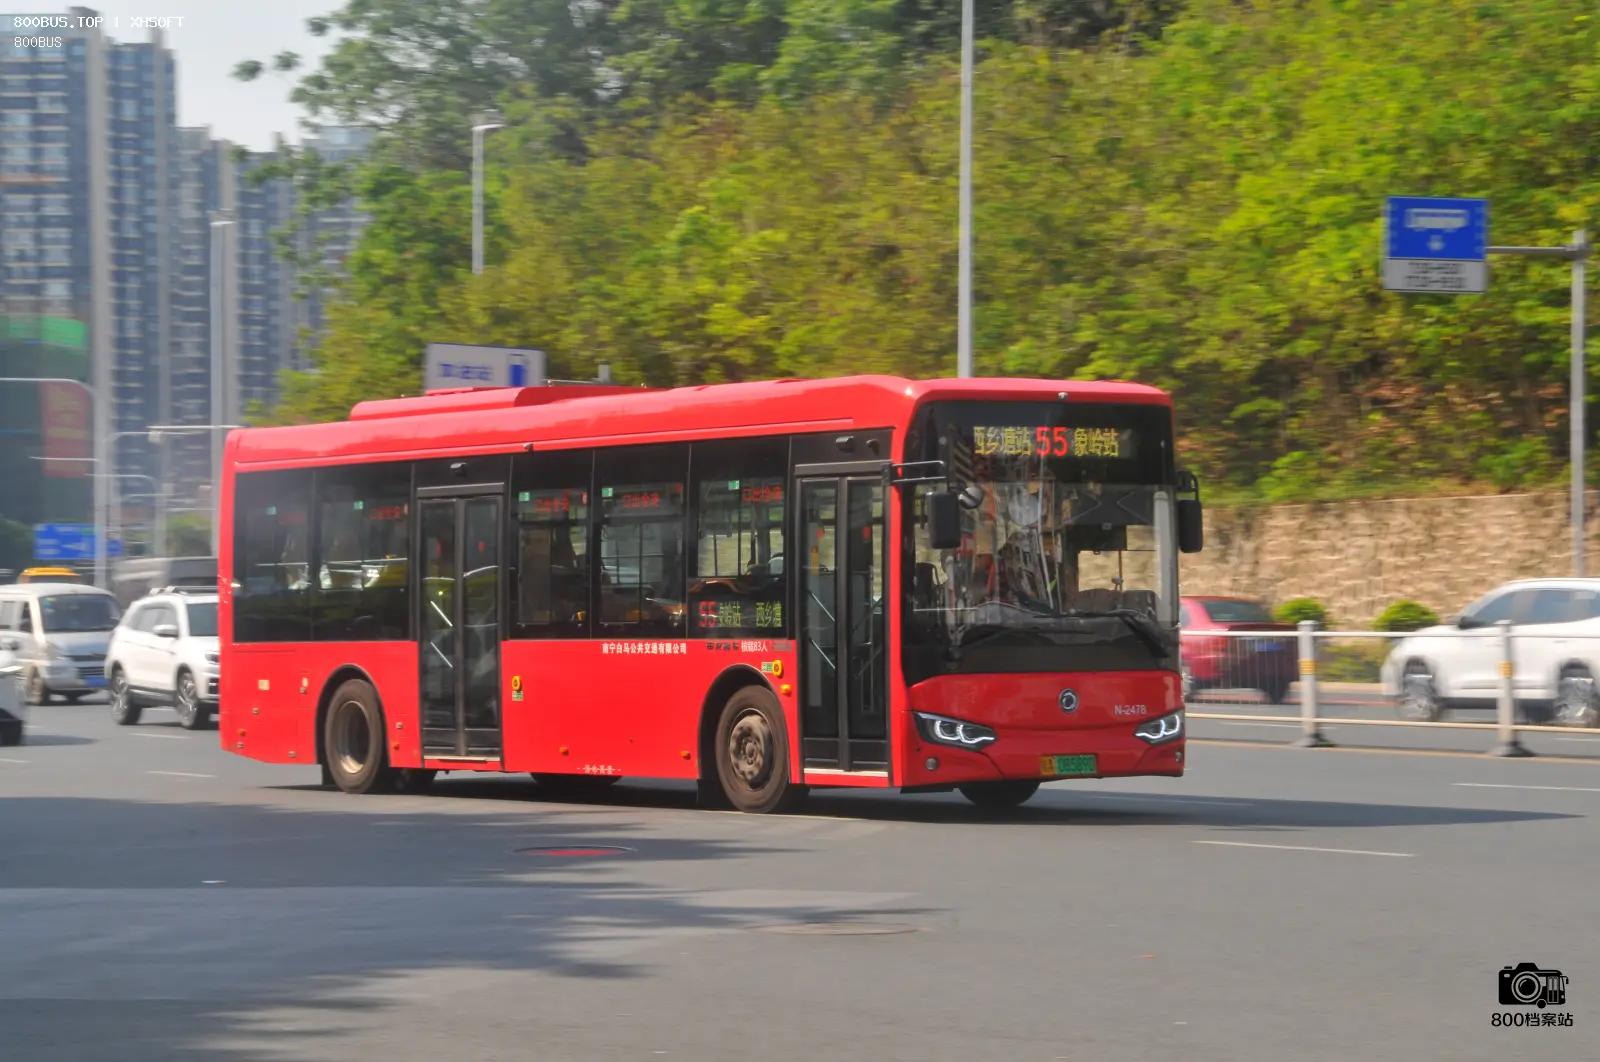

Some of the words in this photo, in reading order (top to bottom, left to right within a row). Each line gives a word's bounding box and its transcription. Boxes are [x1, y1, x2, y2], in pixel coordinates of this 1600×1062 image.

[1035, 426, 1069, 457] 55
[1074, 427, 1119, 457] 象岭站
[699, 601, 717, 628] 55
[602, 642, 687, 655] 南宁白马公共交通有限公司
[1114, 704, 1147, 715] N-2478
